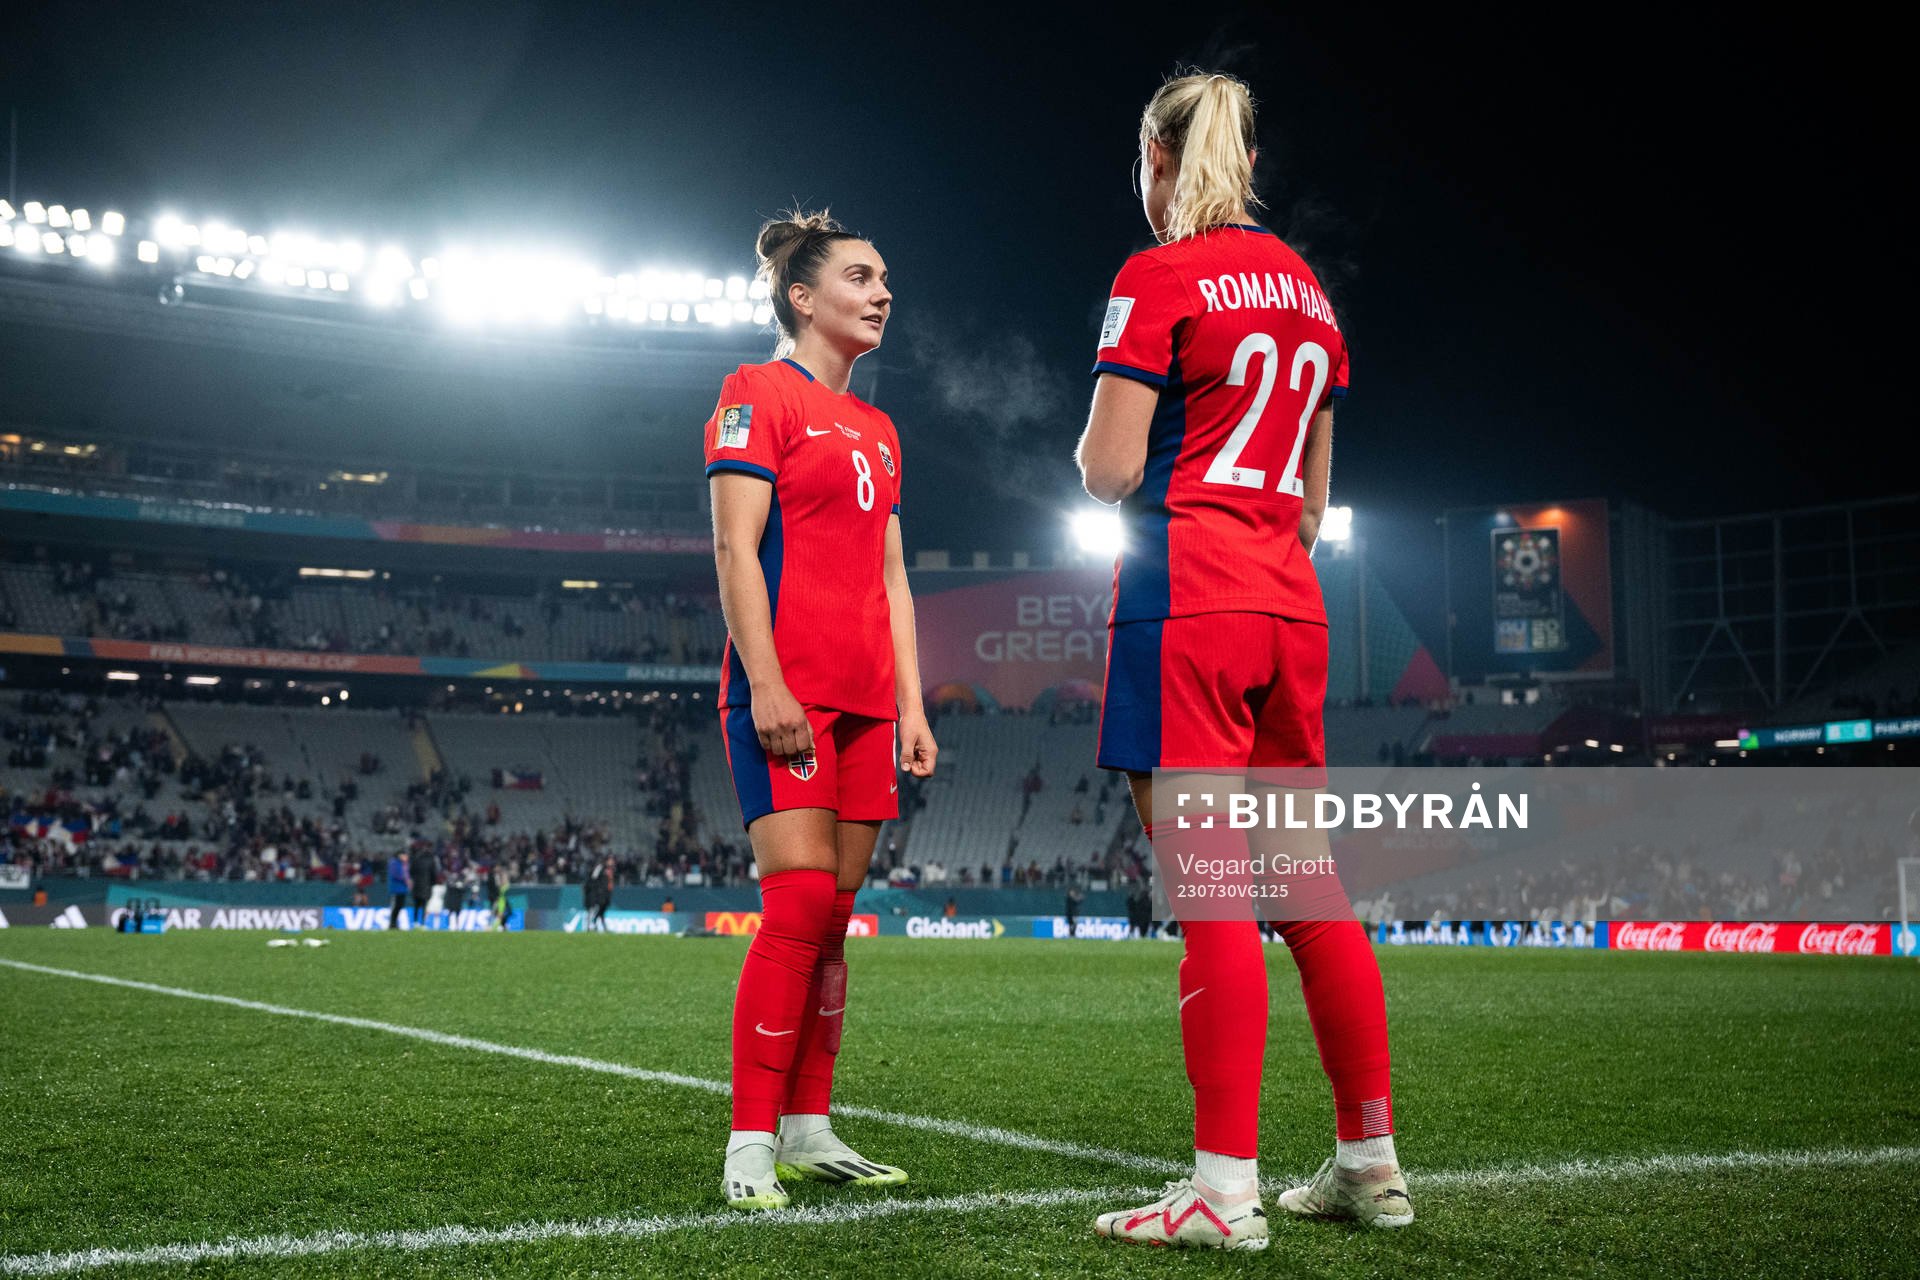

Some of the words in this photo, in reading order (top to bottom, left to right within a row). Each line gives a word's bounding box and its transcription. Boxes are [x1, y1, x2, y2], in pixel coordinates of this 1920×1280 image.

[1197, 272, 1299, 313] ROMAN
[1202, 332, 1329, 498] 22
[852, 450, 875, 512] 8
[210, 907, 319, 931] AIRWAYS
[446, 908, 492, 931] VIS
[906, 916, 992, 939] Globant
